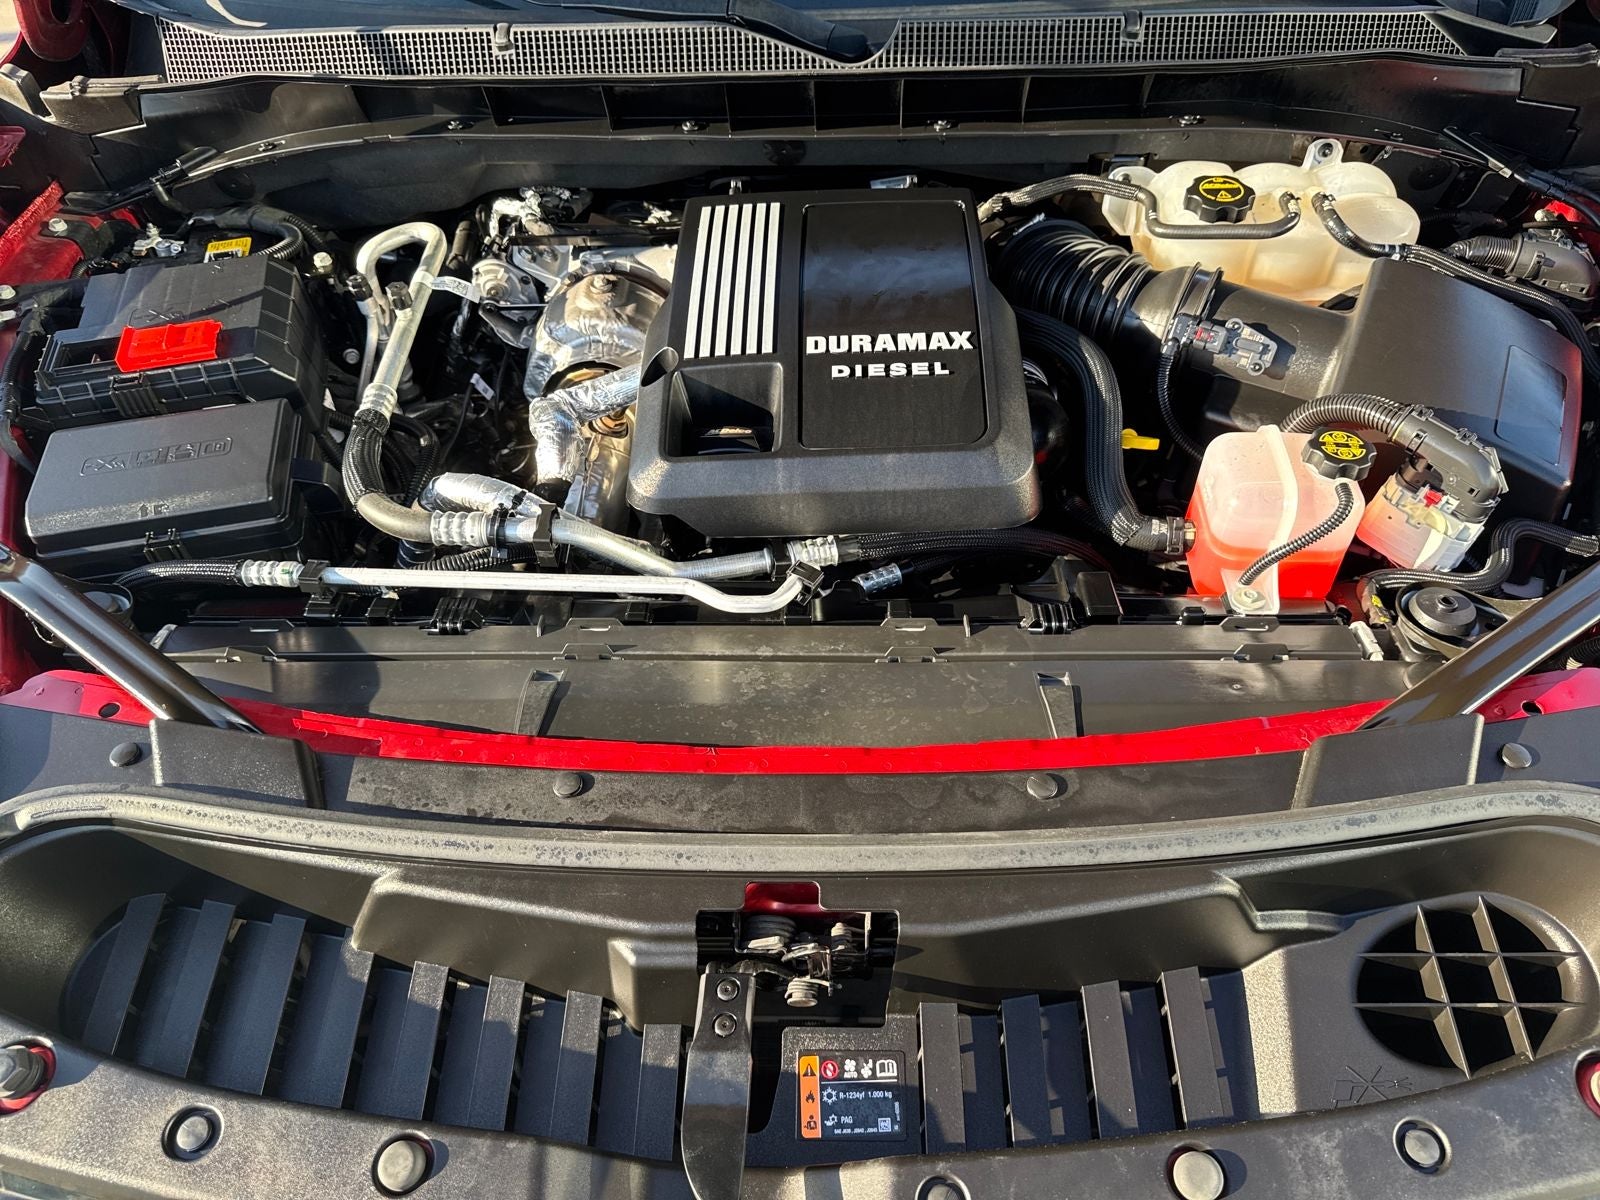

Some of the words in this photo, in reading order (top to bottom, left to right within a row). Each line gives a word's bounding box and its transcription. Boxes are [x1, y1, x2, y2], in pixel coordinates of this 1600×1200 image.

[806, 331, 974, 354] DURAMAX
[831, 362, 950, 379] DIESEL
[839, 1091, 865, 1100] R-1234yf
[885, 1090, 893, 1099] kg
[840, 1116, 853, 1124] PAG
